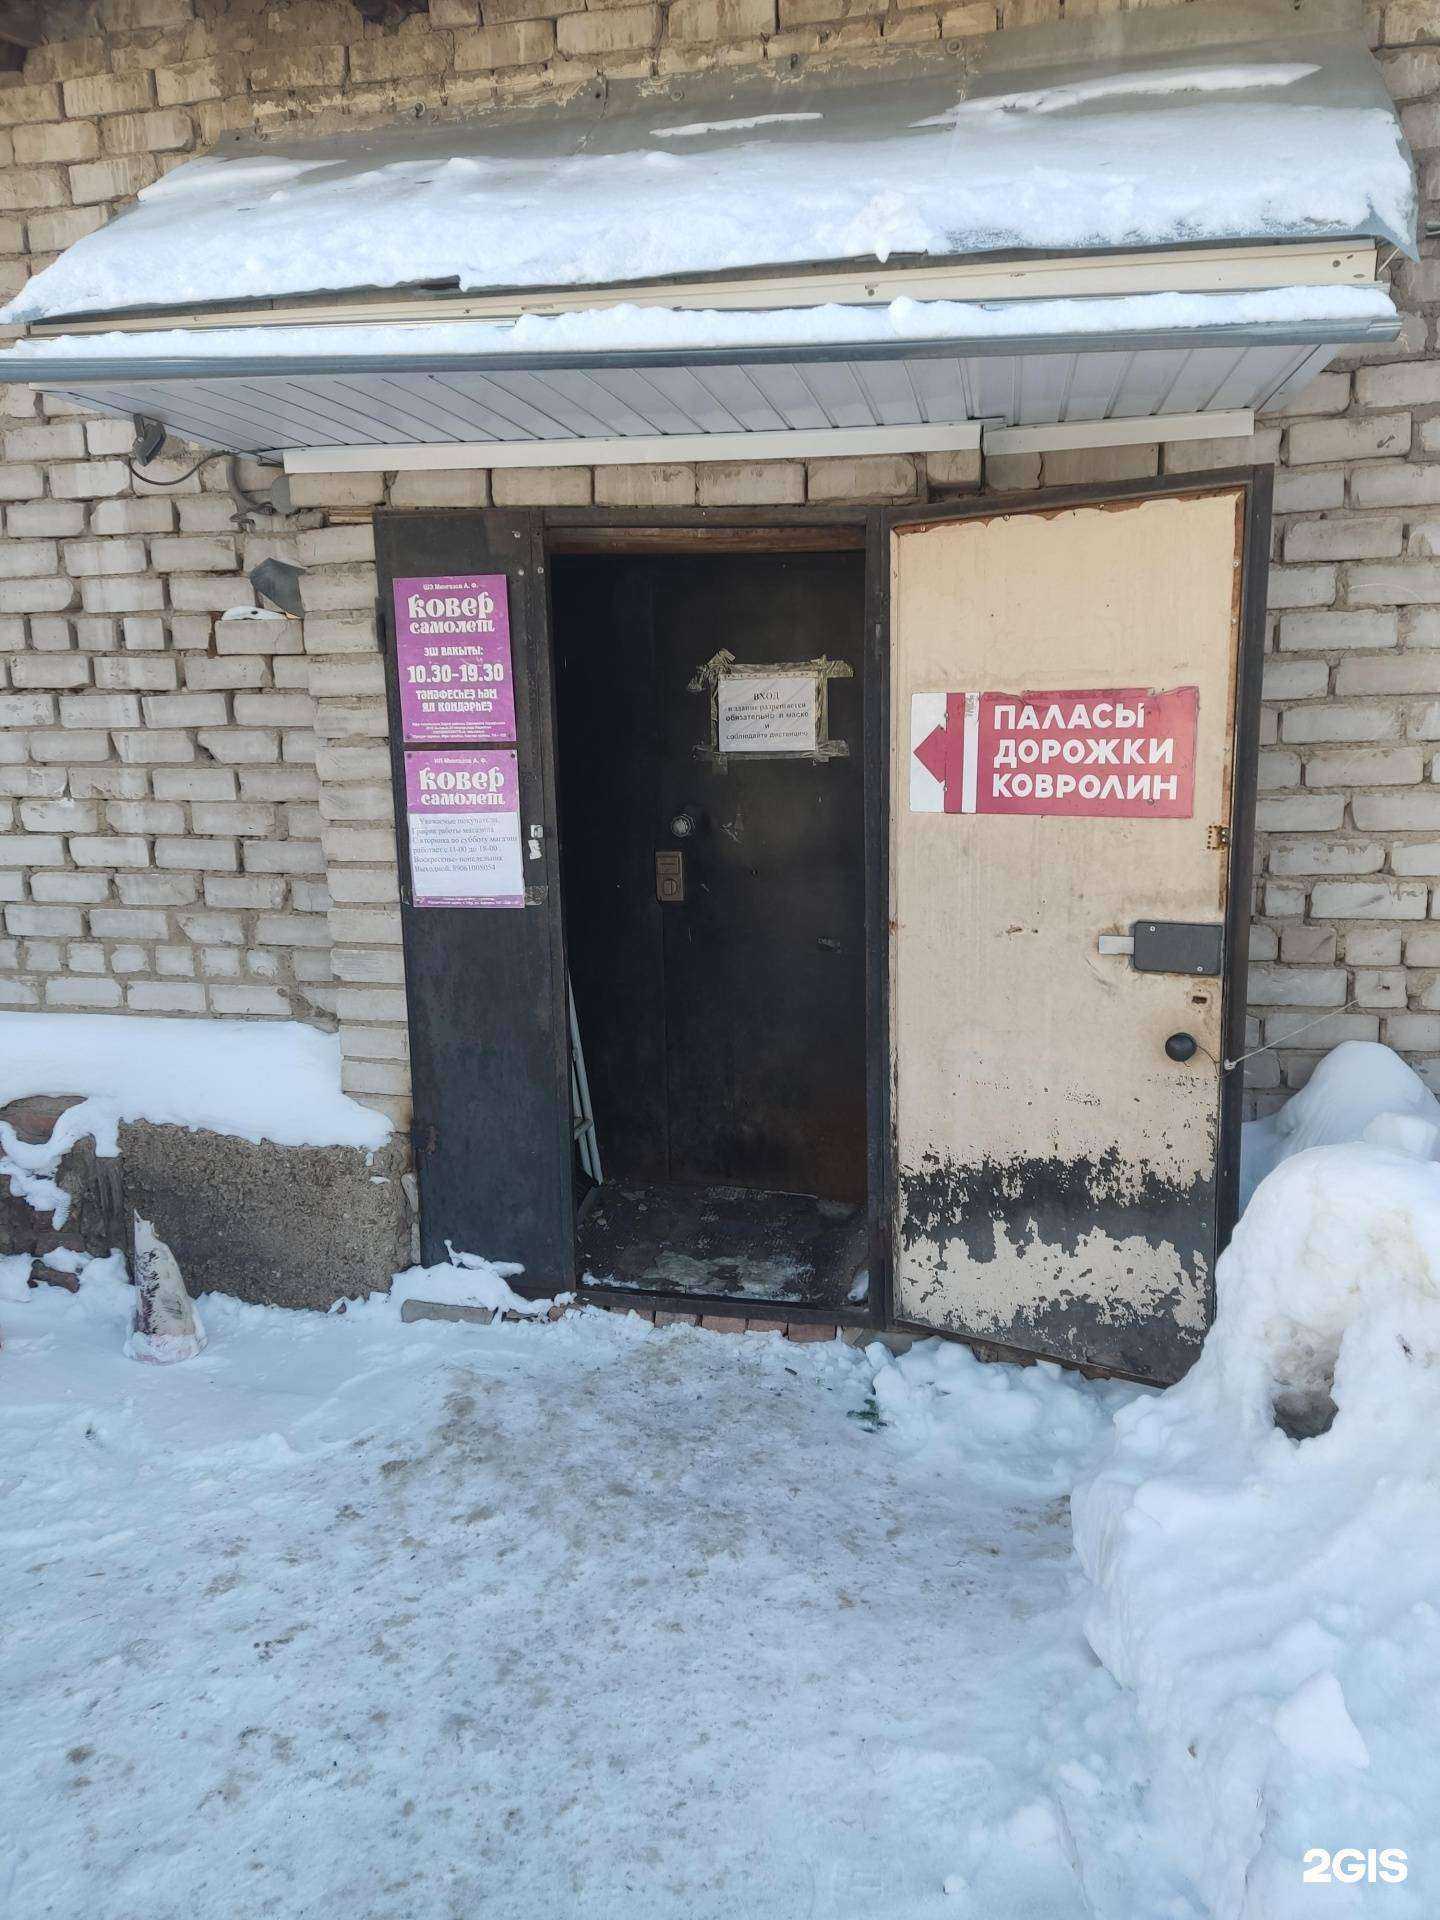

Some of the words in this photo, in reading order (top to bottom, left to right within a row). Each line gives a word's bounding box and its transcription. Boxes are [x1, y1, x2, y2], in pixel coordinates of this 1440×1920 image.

[407, 662, 504, 683] 10.30-19.30
[993, 702, 1145, 730] ПАЛАСЫ
[993, 738, 1175, 769] ДОРОЖКИ
[992, 773, 1178, 800] КОВРОЛИН
